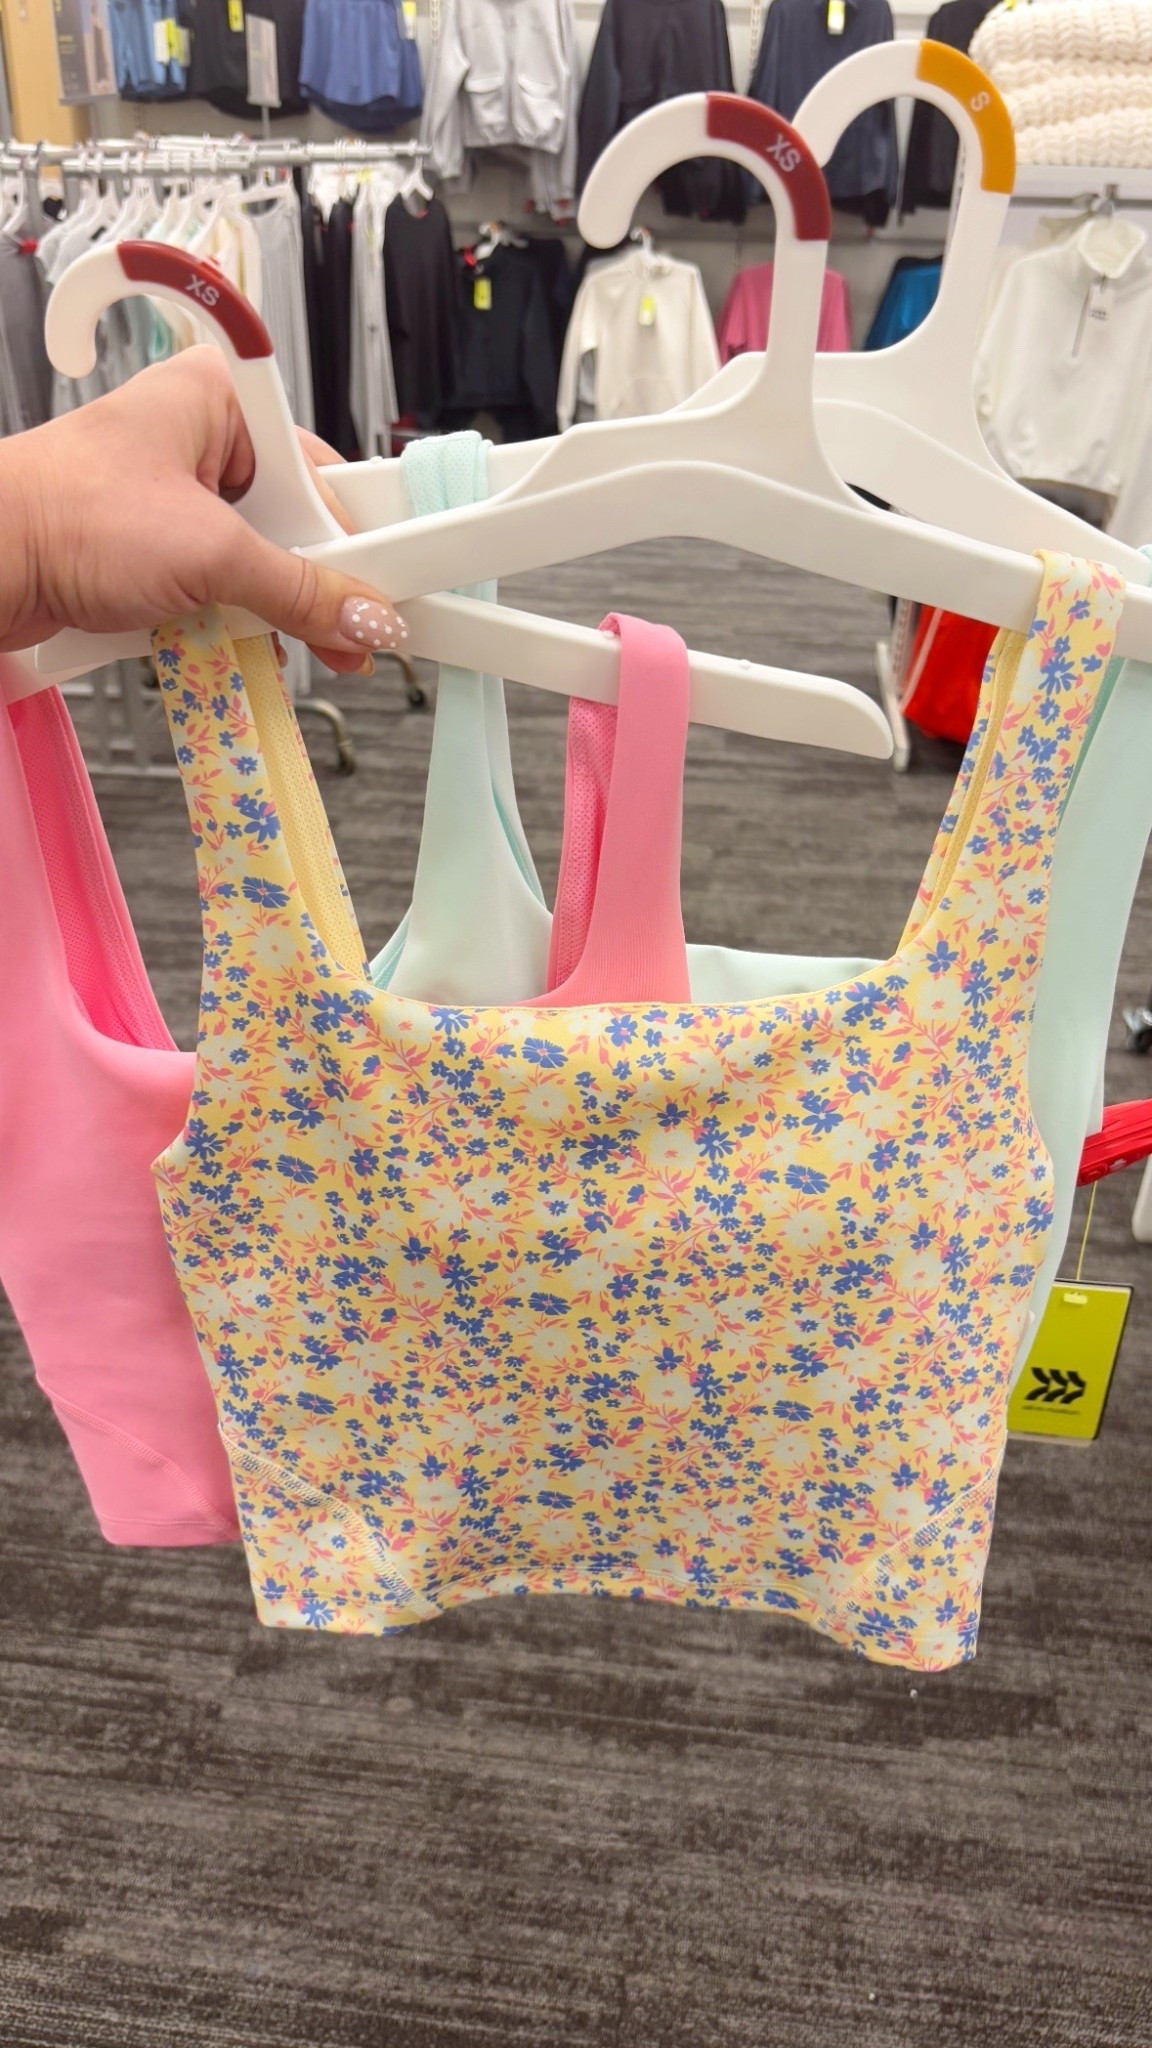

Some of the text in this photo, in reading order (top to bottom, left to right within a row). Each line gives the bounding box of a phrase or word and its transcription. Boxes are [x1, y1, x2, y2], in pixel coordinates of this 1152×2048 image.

[970, 91, 990, 111] S
[766, 133, 801, 172] XS
[185, 273, 220, 306] XS
